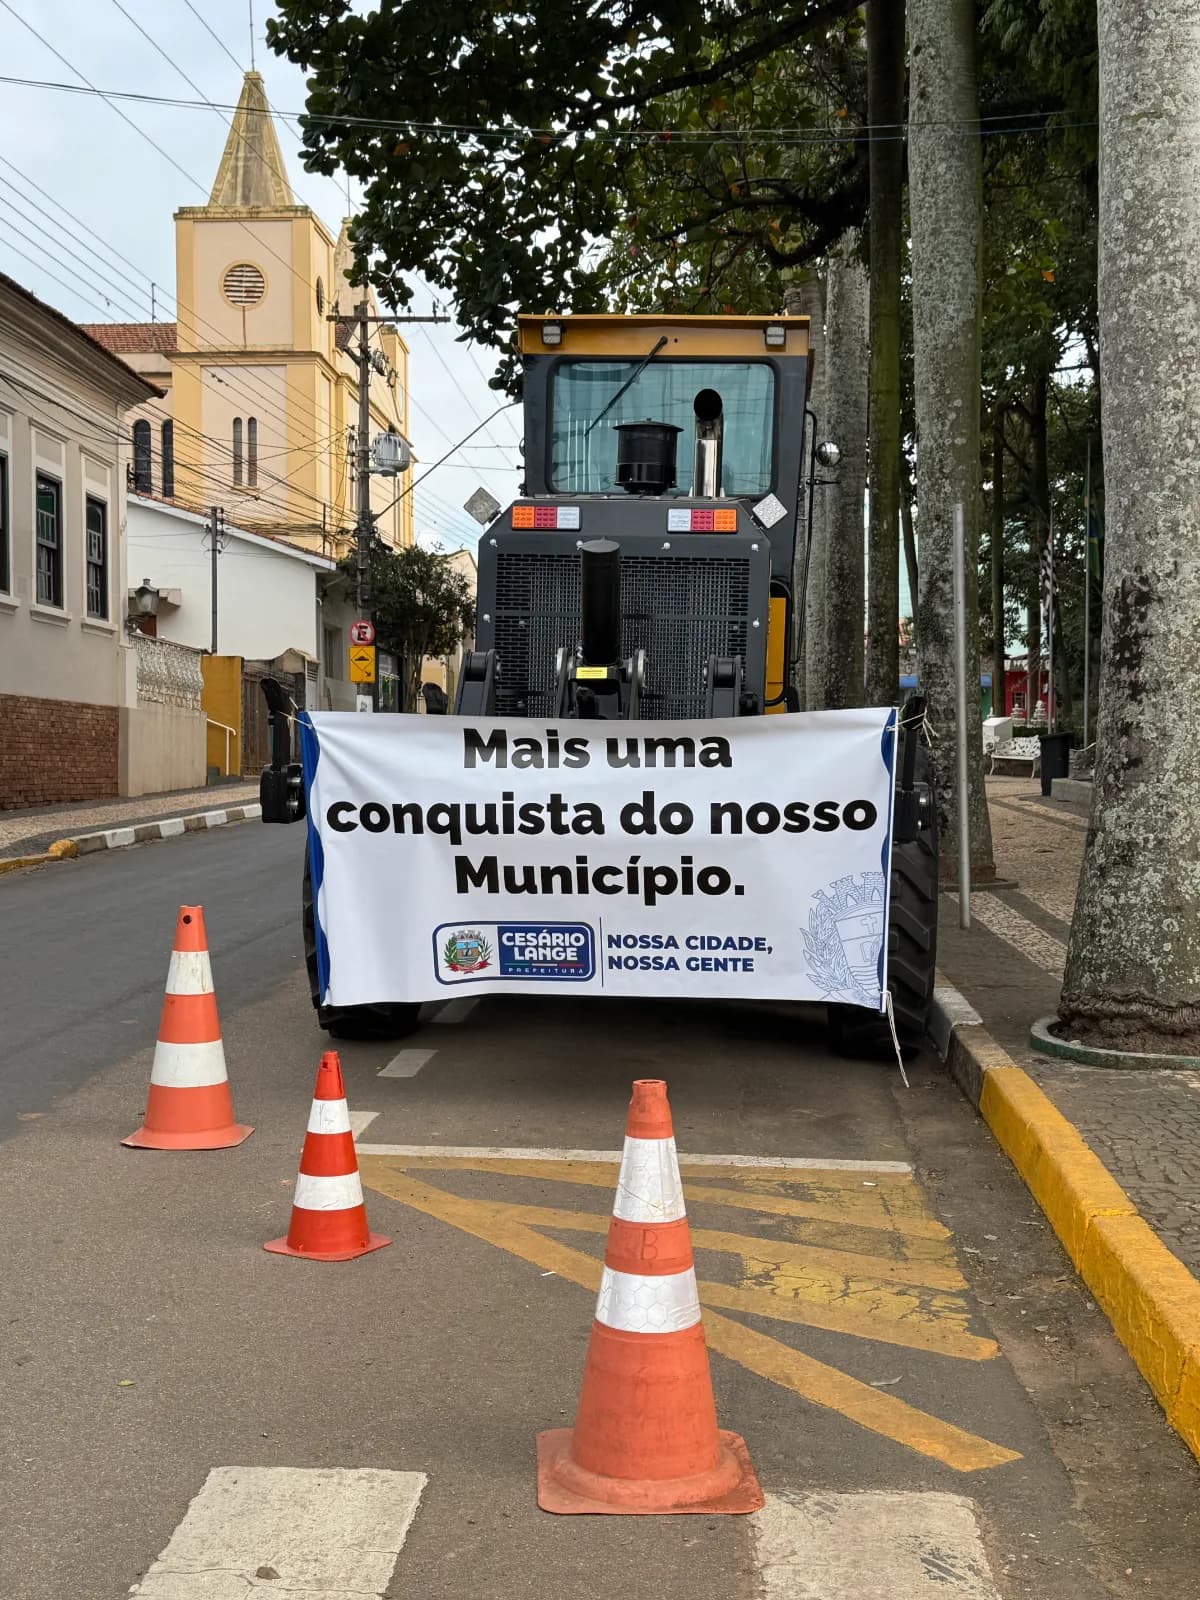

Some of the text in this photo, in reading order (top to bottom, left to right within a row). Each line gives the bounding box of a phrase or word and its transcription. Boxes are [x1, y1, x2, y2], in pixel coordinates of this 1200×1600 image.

[463, 728, 733, 769] Mais uma
[327, 791, 878, 845] conquista do nosso
[455, 855, 745, 906] Município.
[501, 929, 585, 946] CESÁRIO
[607, 934, 773, 954] NOSSA CIDADE,
[514, 947, 578, 961] LANGE
[607, 956, 755, 972] NOSSA GENTE
[640, 1228, 658, 1261] B
